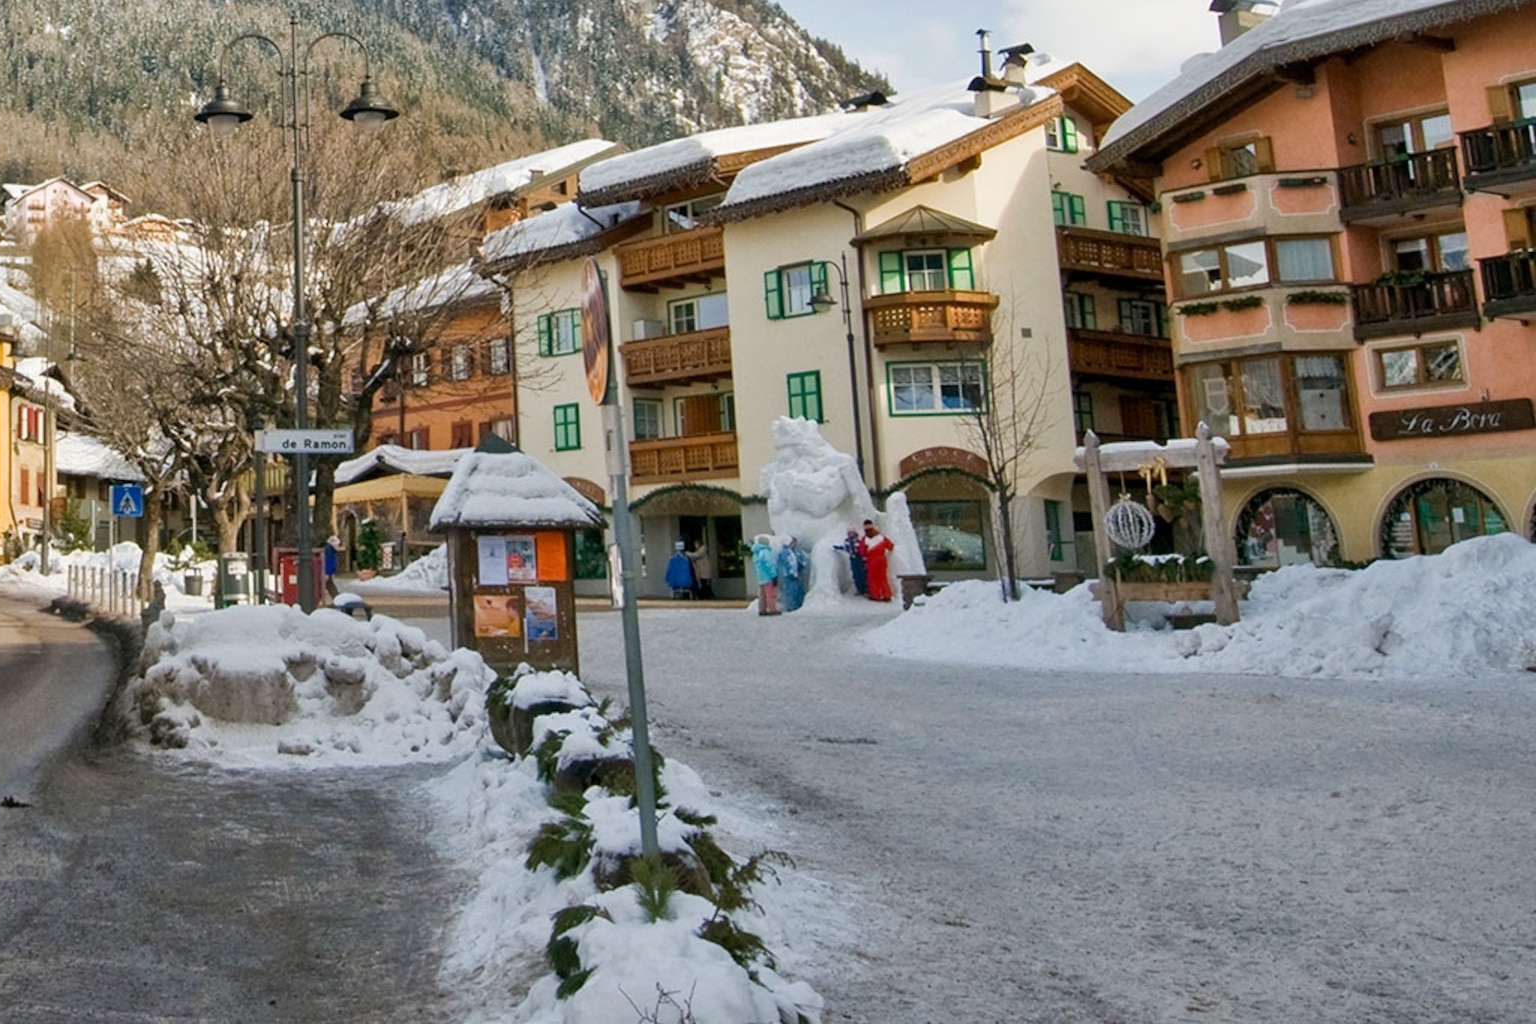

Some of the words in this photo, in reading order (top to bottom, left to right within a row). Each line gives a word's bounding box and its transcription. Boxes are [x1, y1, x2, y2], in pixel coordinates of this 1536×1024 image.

[1398, 412, 1434, 435] La
[1439, 407, 1501, 432] Bora
[282, 438, 297, 449] de
[304, 439, 346, 449] Ramon
